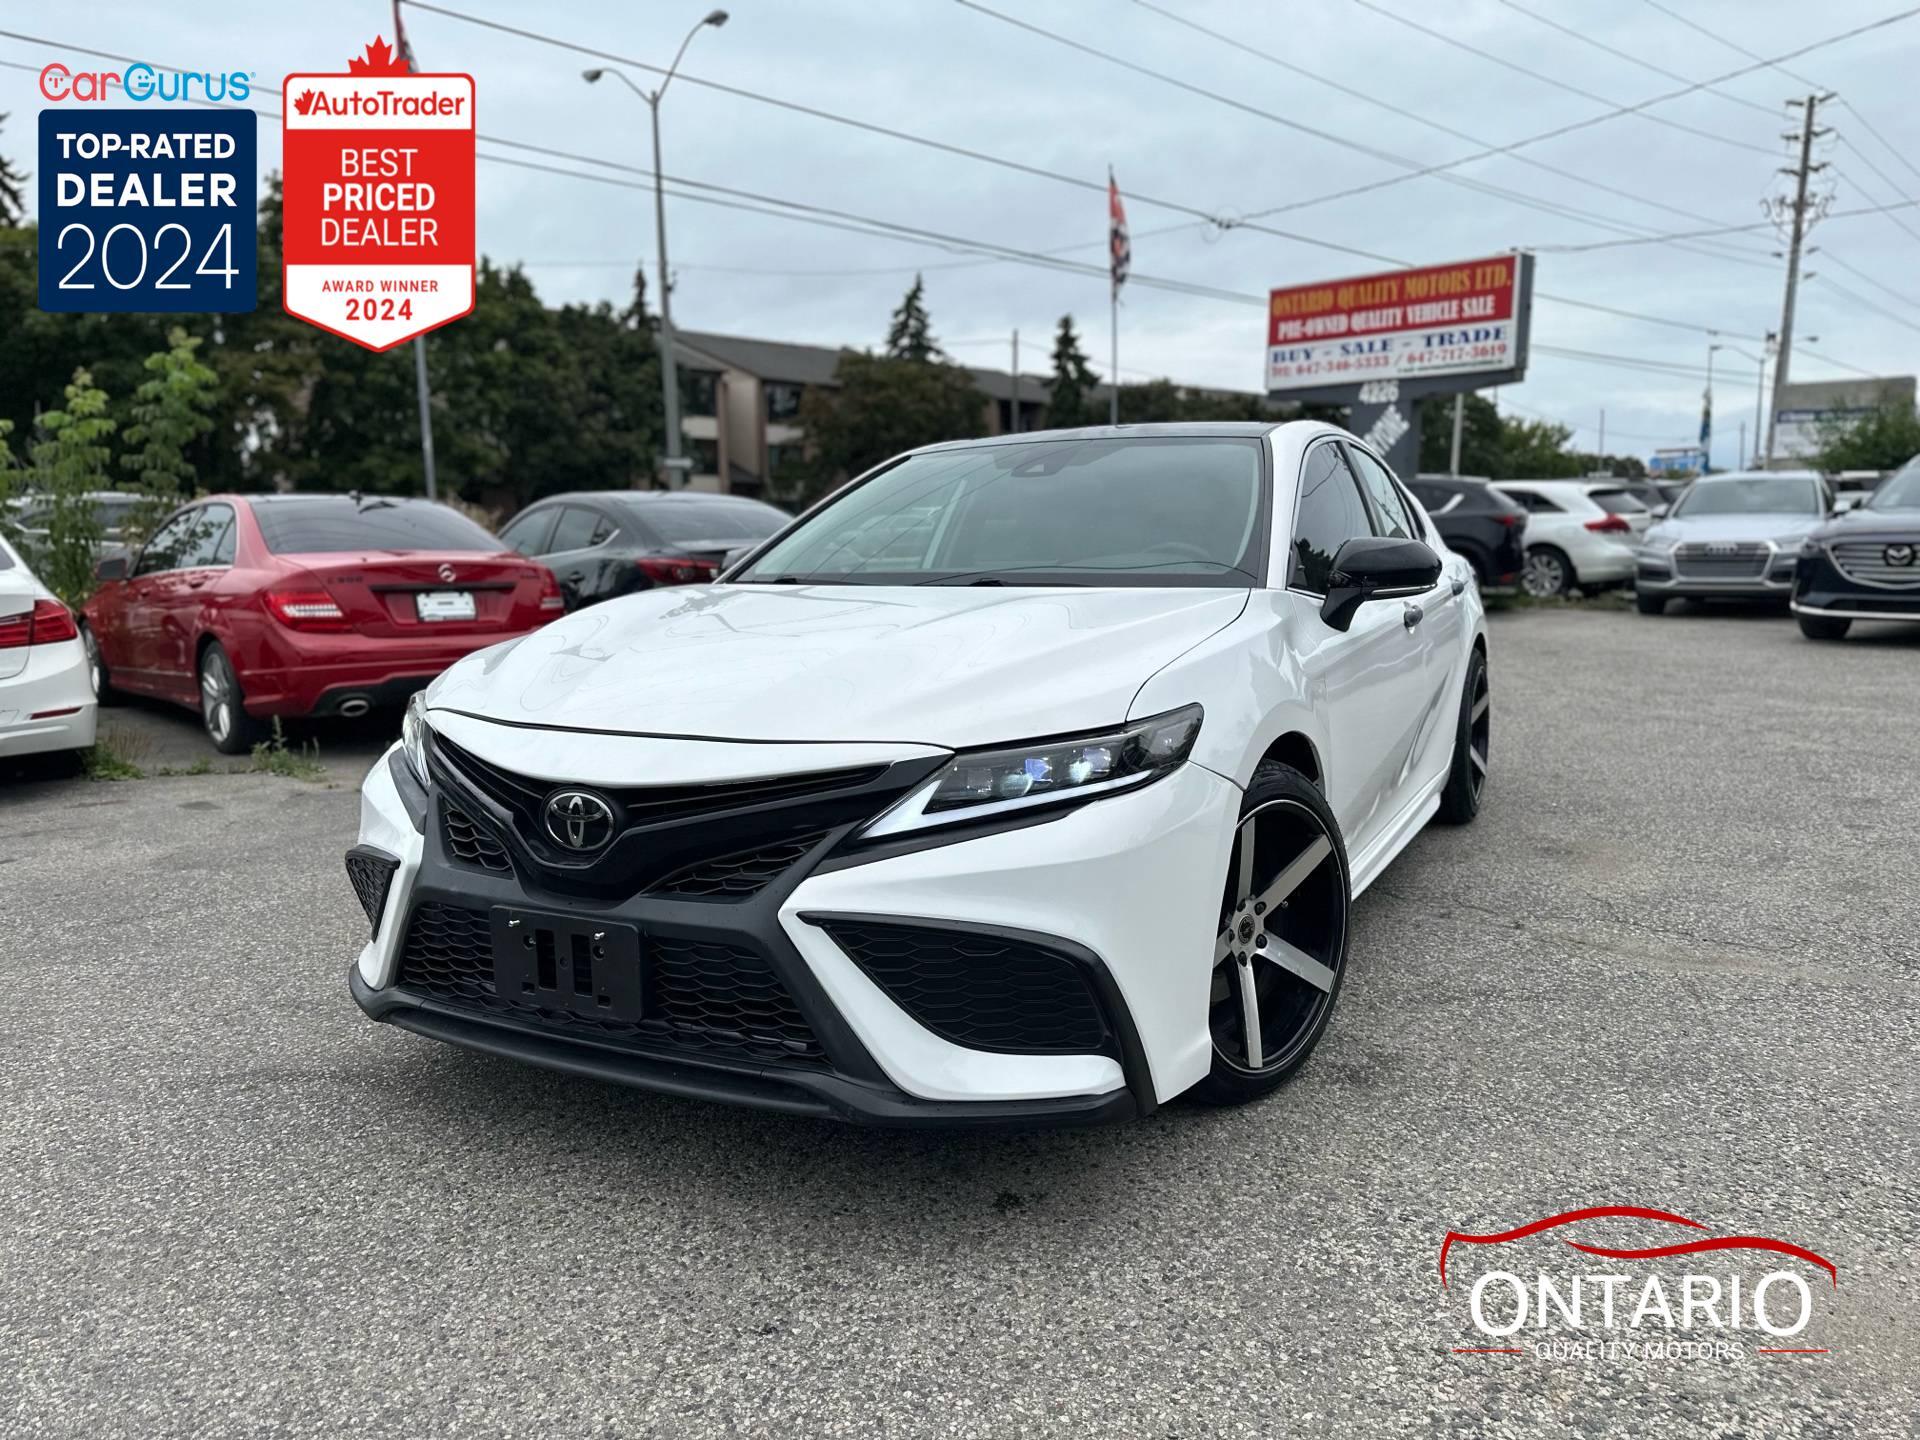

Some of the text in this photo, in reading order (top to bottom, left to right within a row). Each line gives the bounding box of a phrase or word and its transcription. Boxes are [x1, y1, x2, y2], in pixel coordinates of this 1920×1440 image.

[1272, 263, 1512, 317] ONTARIO QUALITY MOTORS LTD.
[1350, 305, 1403, 333] QUALITY
[1405, 298, 1460, 325] VEHICLE
[1461, 293, 1497, 319] SALE
[1272, 347, 1317, 364] BUY
[1340, 338, 1394, 357] SALE
[1424, 326, 1507, 349] TRADE
